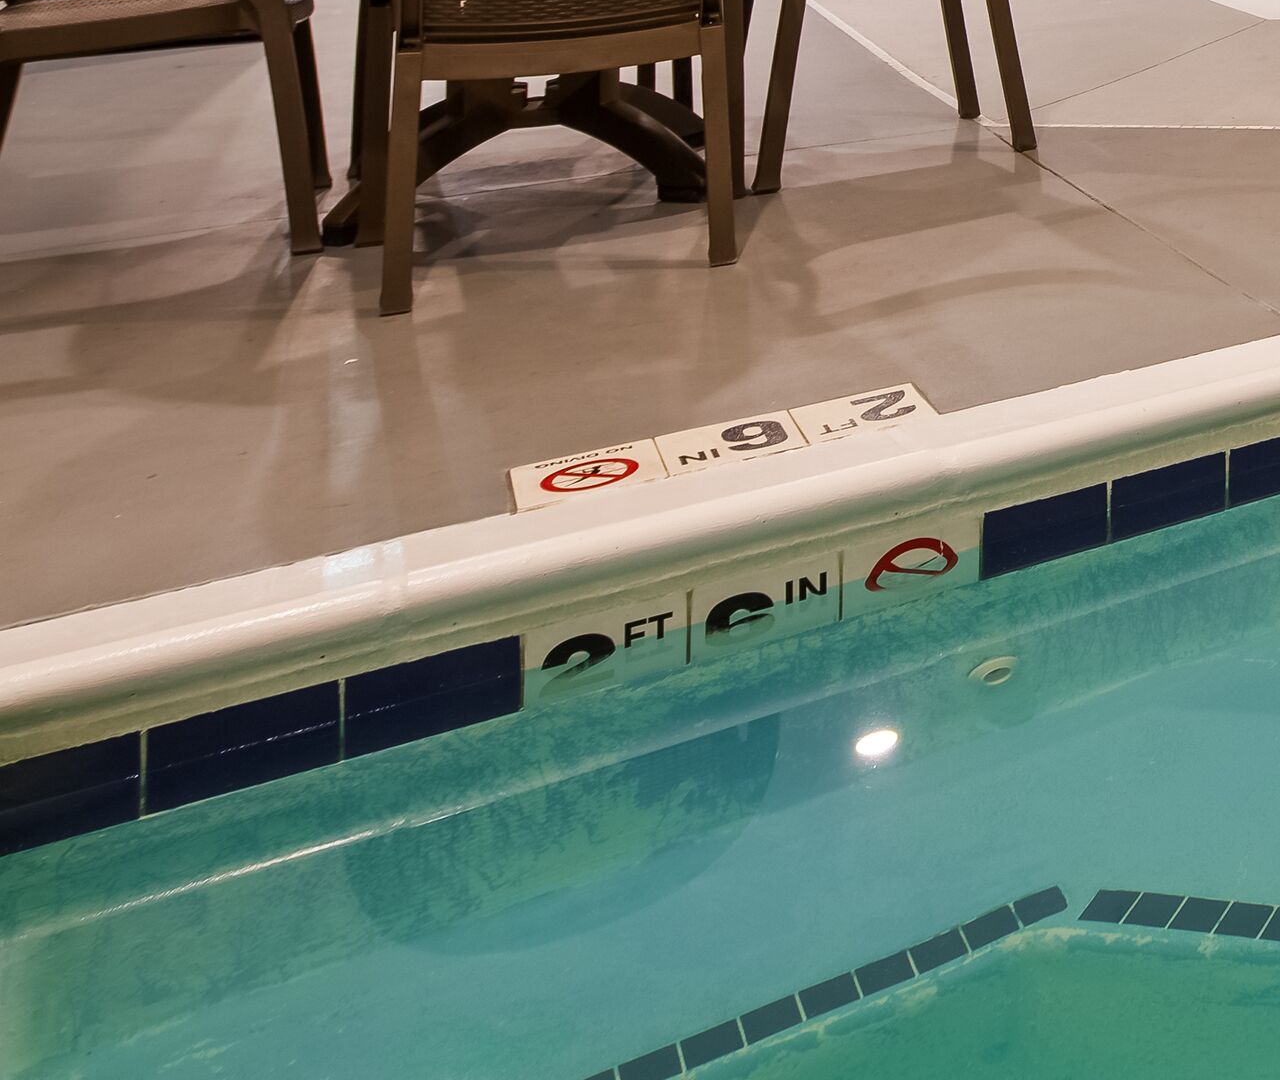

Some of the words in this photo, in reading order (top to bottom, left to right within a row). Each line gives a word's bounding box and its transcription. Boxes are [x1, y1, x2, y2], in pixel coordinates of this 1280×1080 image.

[850, 389, 916, 421] 2
[720, 420, 788, 451] 6
[821, 418, 858, 435] FT
[605, 445, 633, 454] NO
[678, 448, 719, 466] IN
[534, 452, 599, 469] DIVING
[624, 611, 673, 649] FT
[785, 571, 828, 605] IN
